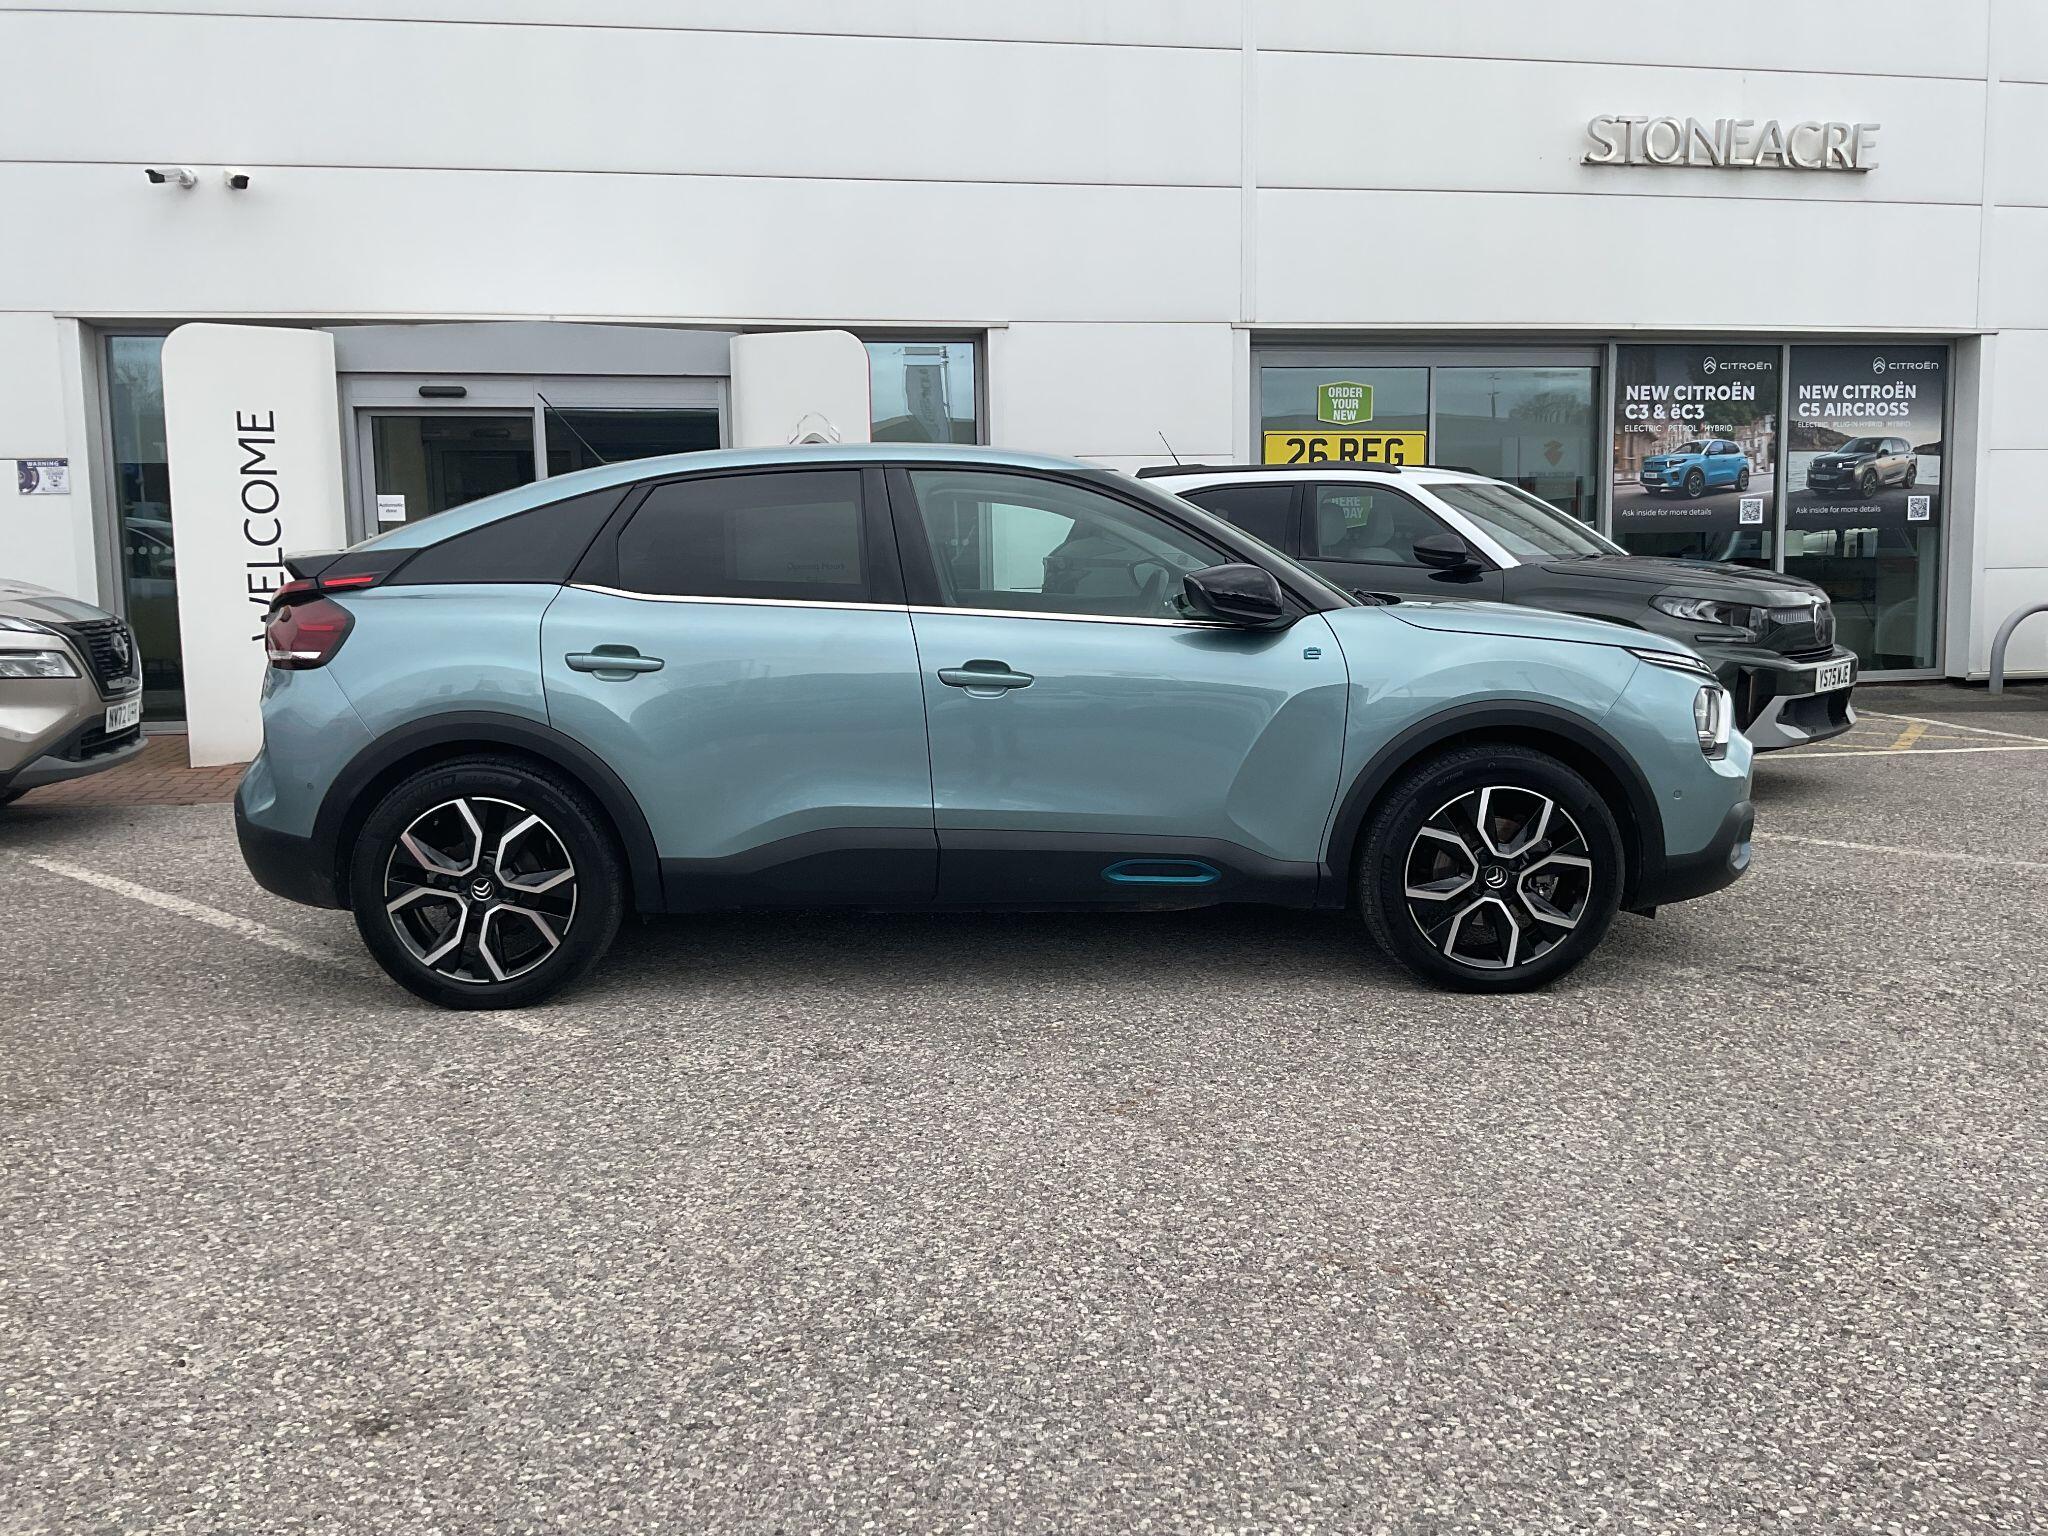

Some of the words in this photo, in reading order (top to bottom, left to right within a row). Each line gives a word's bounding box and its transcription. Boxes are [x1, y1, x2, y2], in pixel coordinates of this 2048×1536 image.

[1583, 115, 1880, 169] STONEACRE
[1328, 387, 1363, 398] ORDER
[1626, 385, 1669, 400] NEW
[1673, 381, 1755, 400] CITROËN
[1799, 384, 1838, 399] NEW
[1842, 381, 1917, 399] CITROËN
[1332, 399, 1359, 410] YOUR
[1798, 403, 1820, 417] C5
[1824, 402, 1909, 417] AIRCROSS
[1333, 410, 1357, 421] NEW
[1625, 404, 1649, 419] C3
[1653, 404, 1666, 419] &
[1670, 404, 1705, 419] ëC3
[1624, 424, 1662, 432] ELECTRIC
[1668, 424, 1699, 432] PETROL
[1704, 424, 1733, 432] HYBRID
[1286, 438, 1328, 465] 26
[1339, 438, 1404, 466] REG
[1688, 508, 1712, 516] details
[1830, 506, 1839, 514] for
[1859, 505, 1881, 513] details
